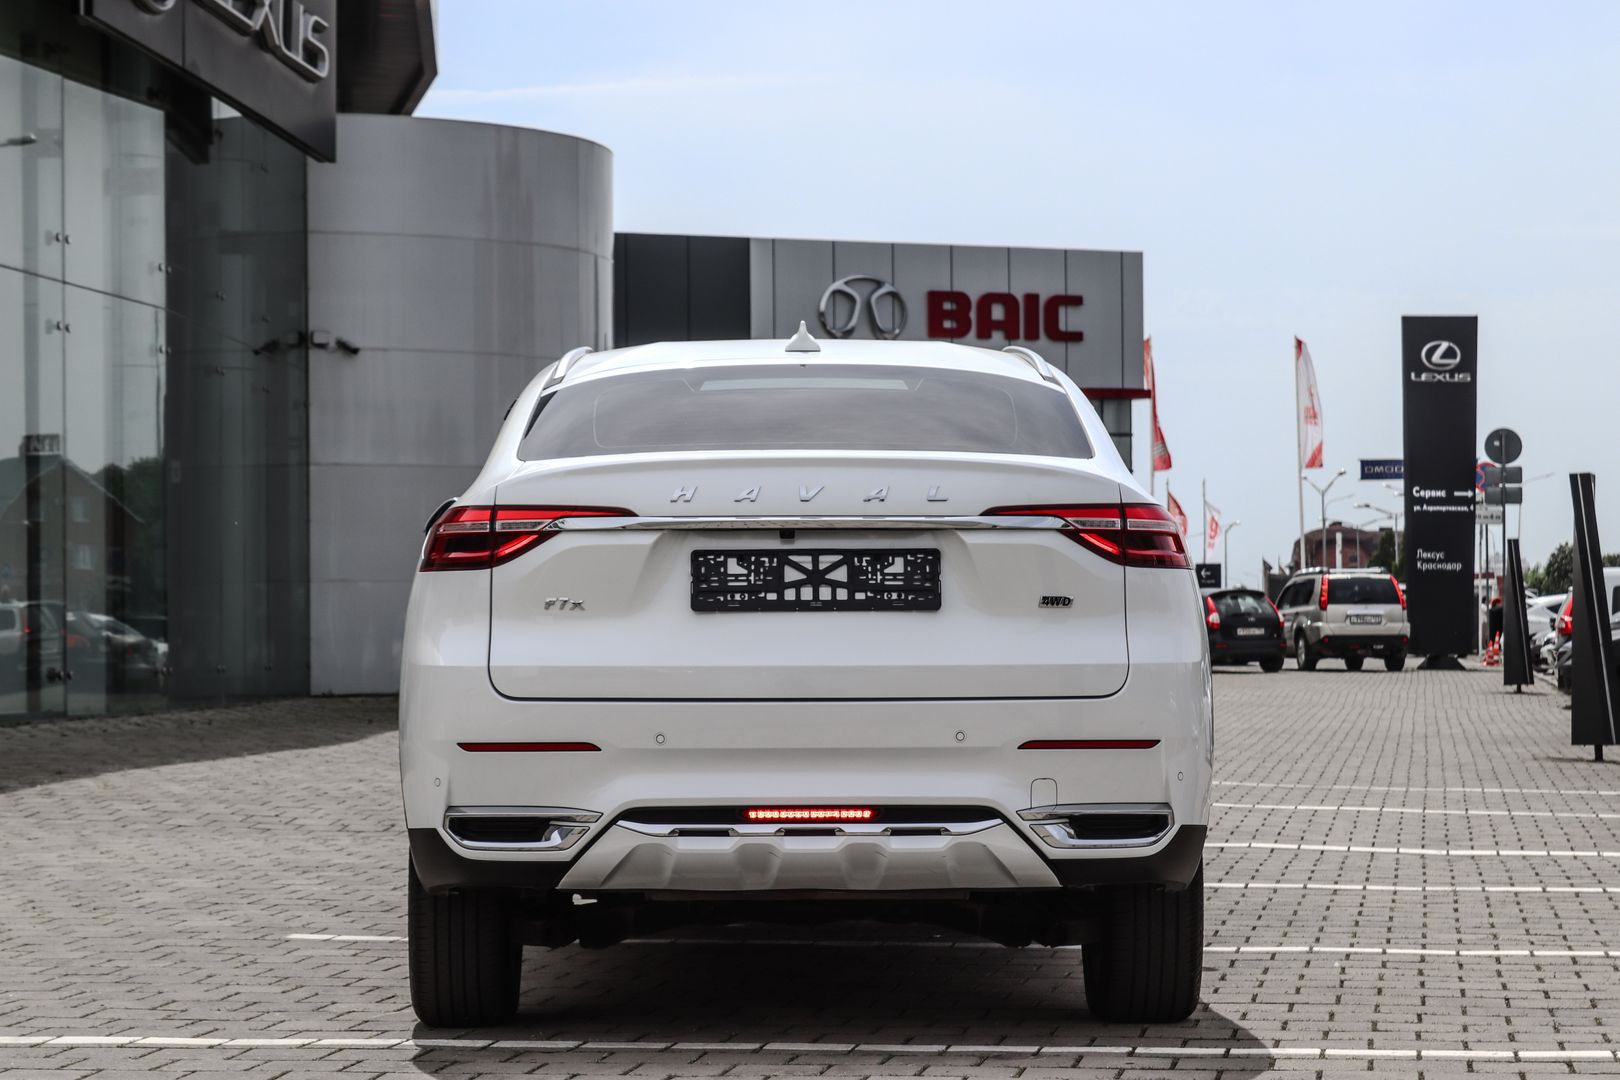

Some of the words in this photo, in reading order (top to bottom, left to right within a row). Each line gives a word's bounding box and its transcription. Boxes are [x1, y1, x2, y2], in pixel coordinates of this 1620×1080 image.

[927, 289, 1084, 343] BAIC
[1410, 371, 1472, 383] LEXUS
[1364, 465, 1404, 474] OMOD
[670, 486, 949, 503] HAVAL
[1412, 486, 1446, 499] Сервис
[1416, 548, 1445, 561] Лексус
[1416, 560, 1463, 572] Краснодар
[1040, 595, 1072, 607] 4WD
